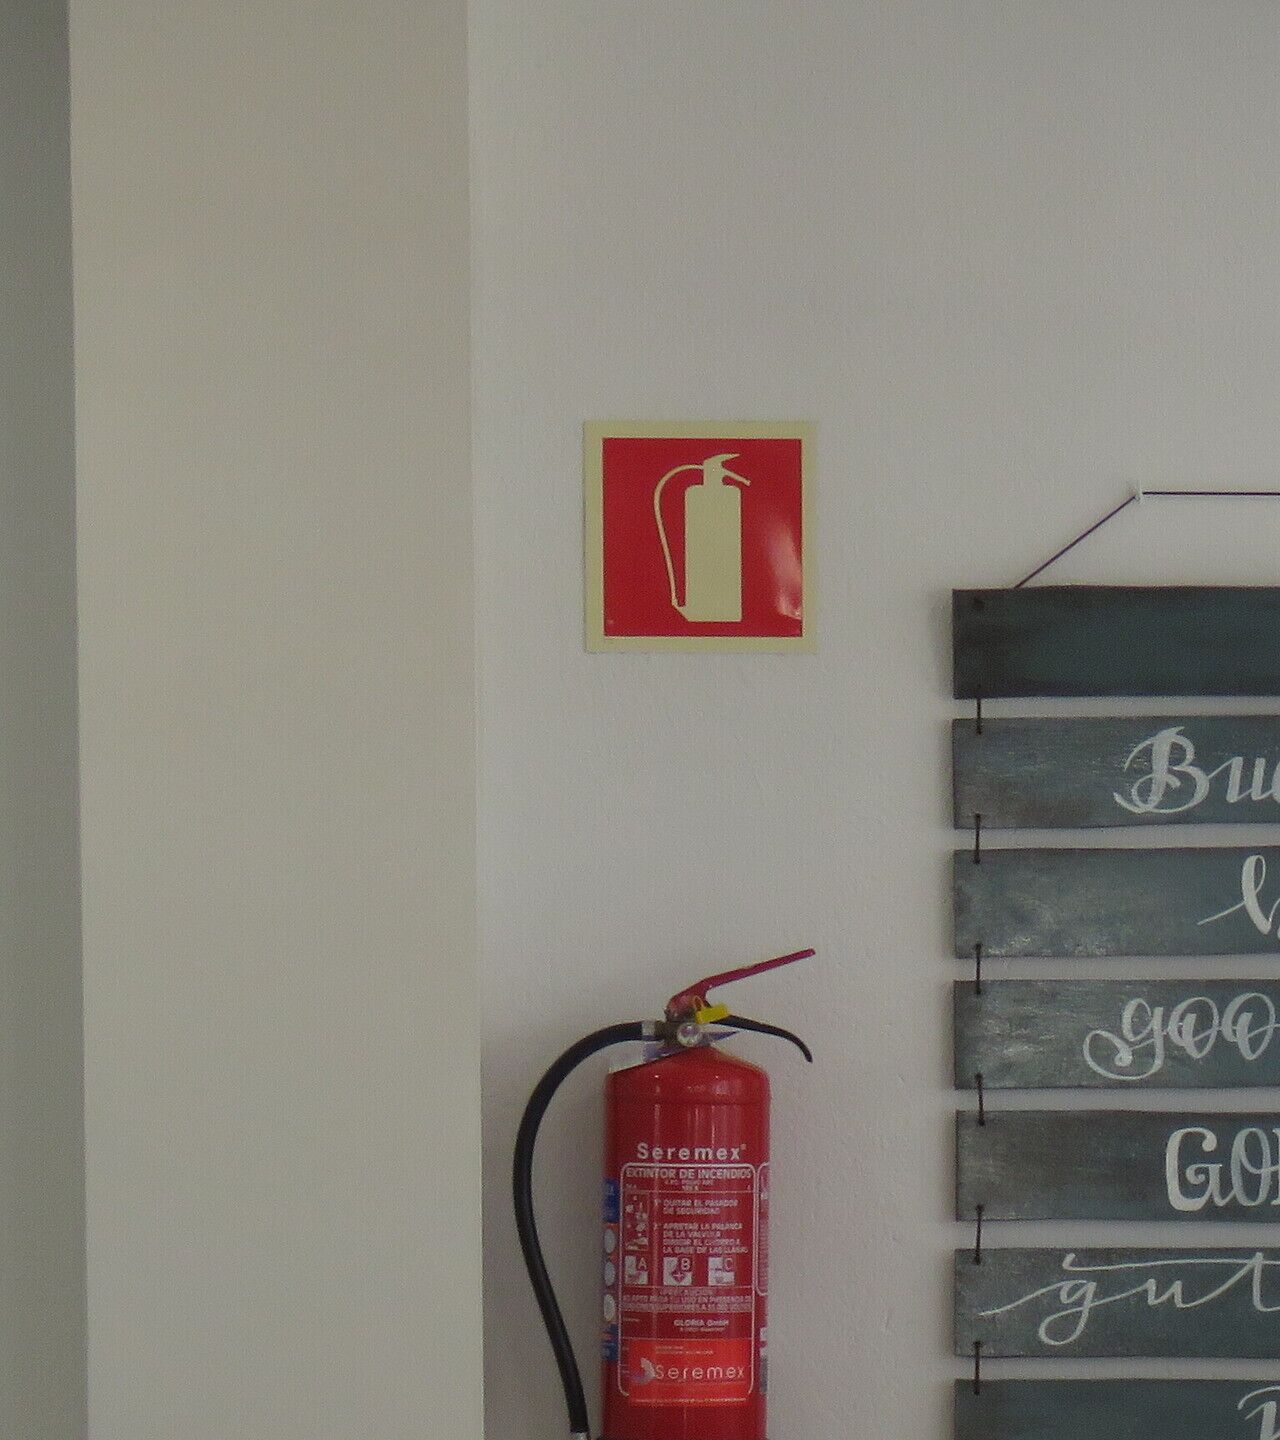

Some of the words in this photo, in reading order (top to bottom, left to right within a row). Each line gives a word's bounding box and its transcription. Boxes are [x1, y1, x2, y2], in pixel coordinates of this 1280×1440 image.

[637, 1142, 741, 1161] Seremex
[626, 1168, 676, 1179] EXTINTOR
[679, 1168, 695, 1179] DE
[698, 1168, 751, 1179] INCENDIOS
[638, 1257, 647, 1271] A
[681, 1257, 691, 1271] B
[655, 1364, 745, 1379] Seremex
